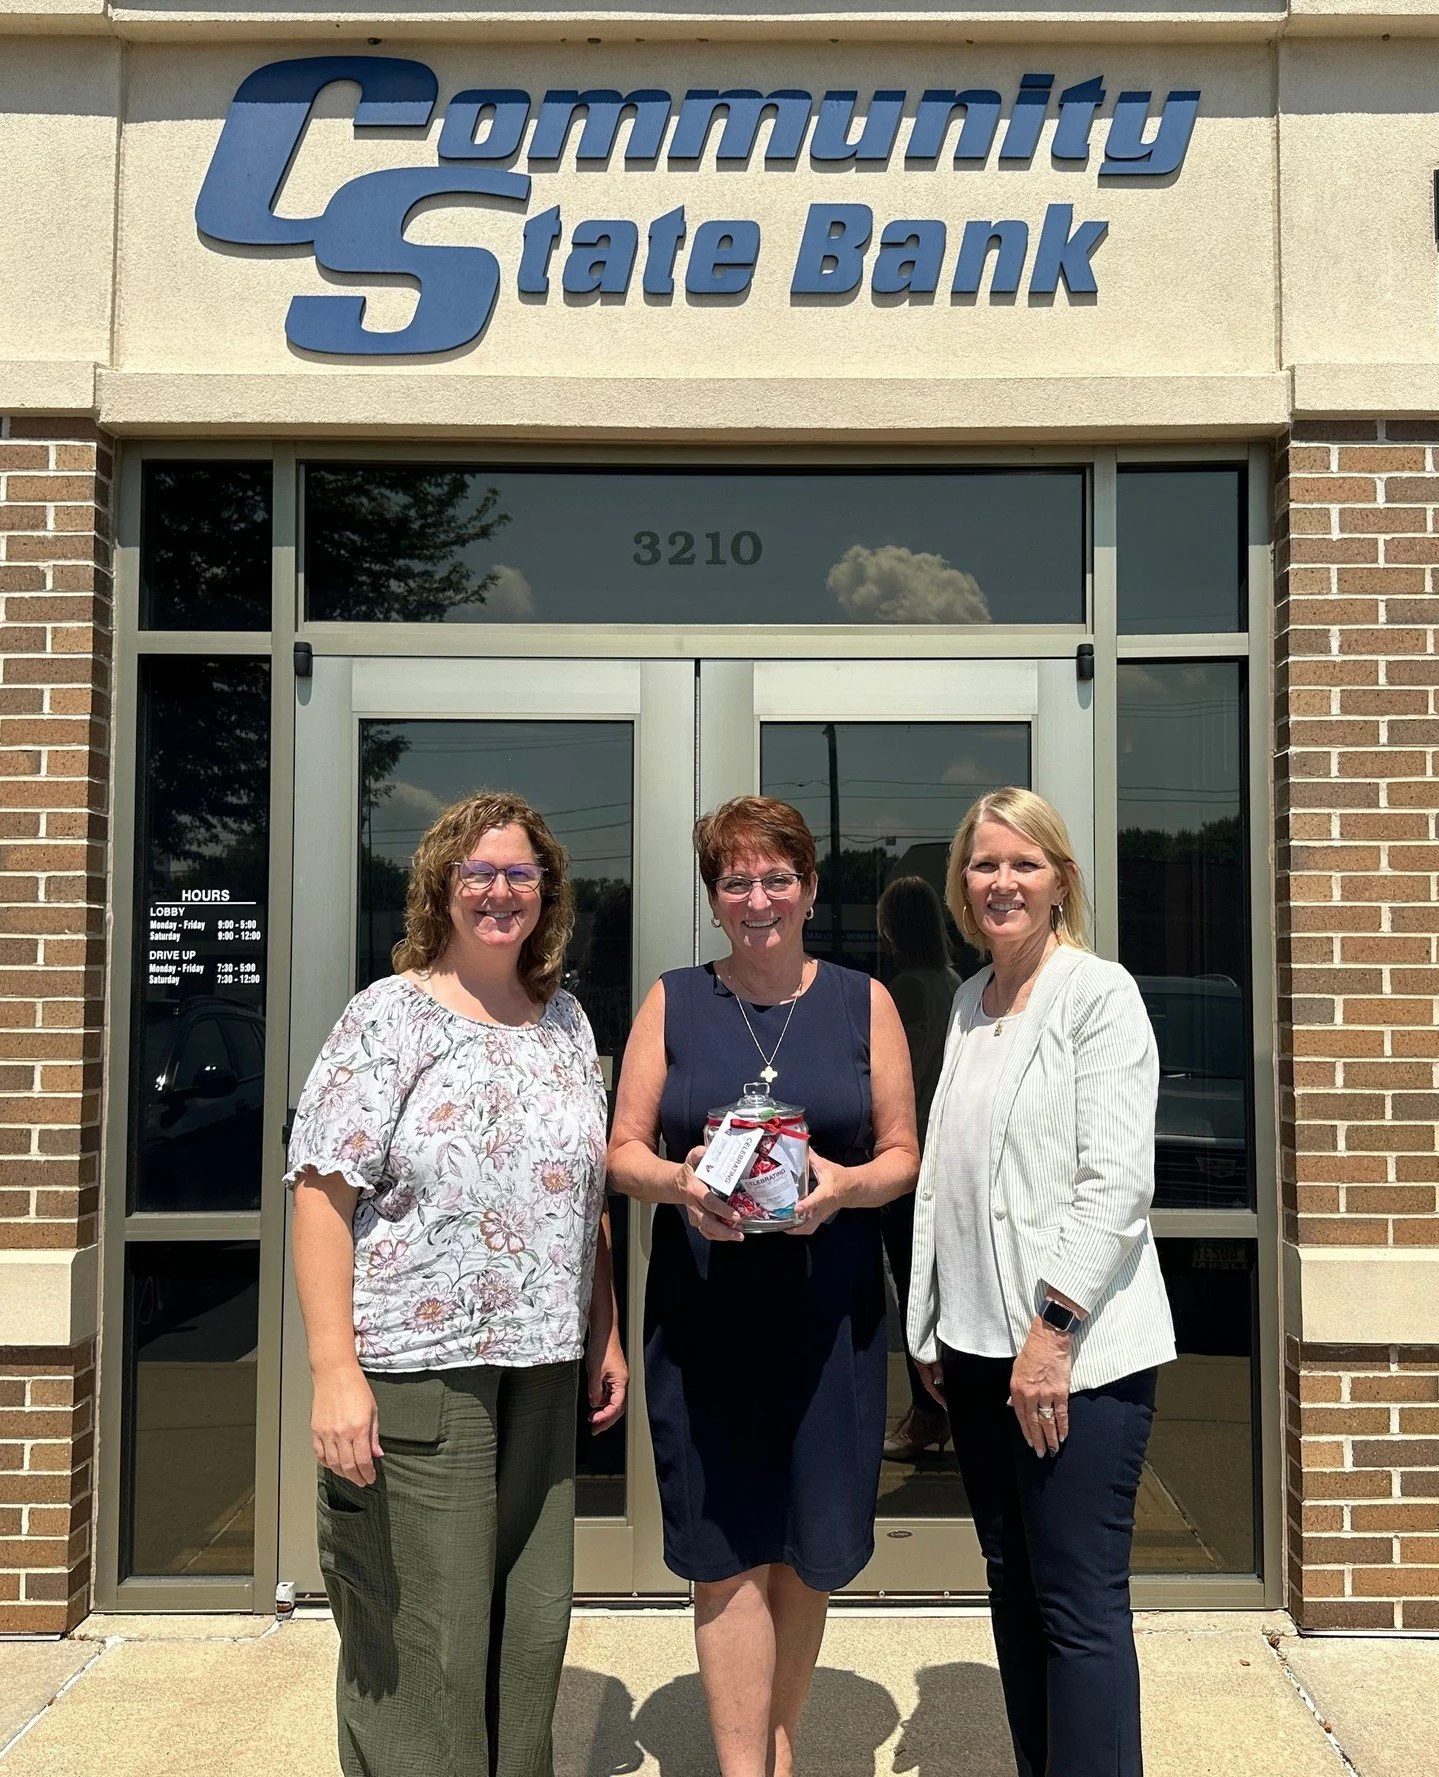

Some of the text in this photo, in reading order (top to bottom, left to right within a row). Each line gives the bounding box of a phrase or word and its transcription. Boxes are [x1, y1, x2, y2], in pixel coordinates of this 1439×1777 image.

[195, 56, 1201, 246] Community
[284, 166, 1109, 355] State Bank
[632, 530, 763, 566] 3210
[182, 889, 230, 901] HOURS
[150, 907, 185, 916] LOBBY
[150, 920, 177, 930] Monday
[183, 920, 205, 931] Friday
[217, 920, 233, 929] 9:00
[240, 920, 256, 929] 5:00
[150, 931, 180, 942] Saturday
[217, 931, 233, 940] 9:00
[241, 931, 261, 940] 12:00
[149, 951, 196, 960] DRIVE UP
[149, 964, 176, 974] Monday
[182, 964, 204, 974] Friday
[217, 963, 233, 972] 7:30
[240, 963, 256, 972] 5:00
[149, 975, 180, 985] Saturday
[217, 975, 233, 984] 7:30
[240, 975, 260, 983] 12:00
[725, 1137, 753, 1184] CELEBRATING
[745, 1168, 786, 1187] CELEBRATING
